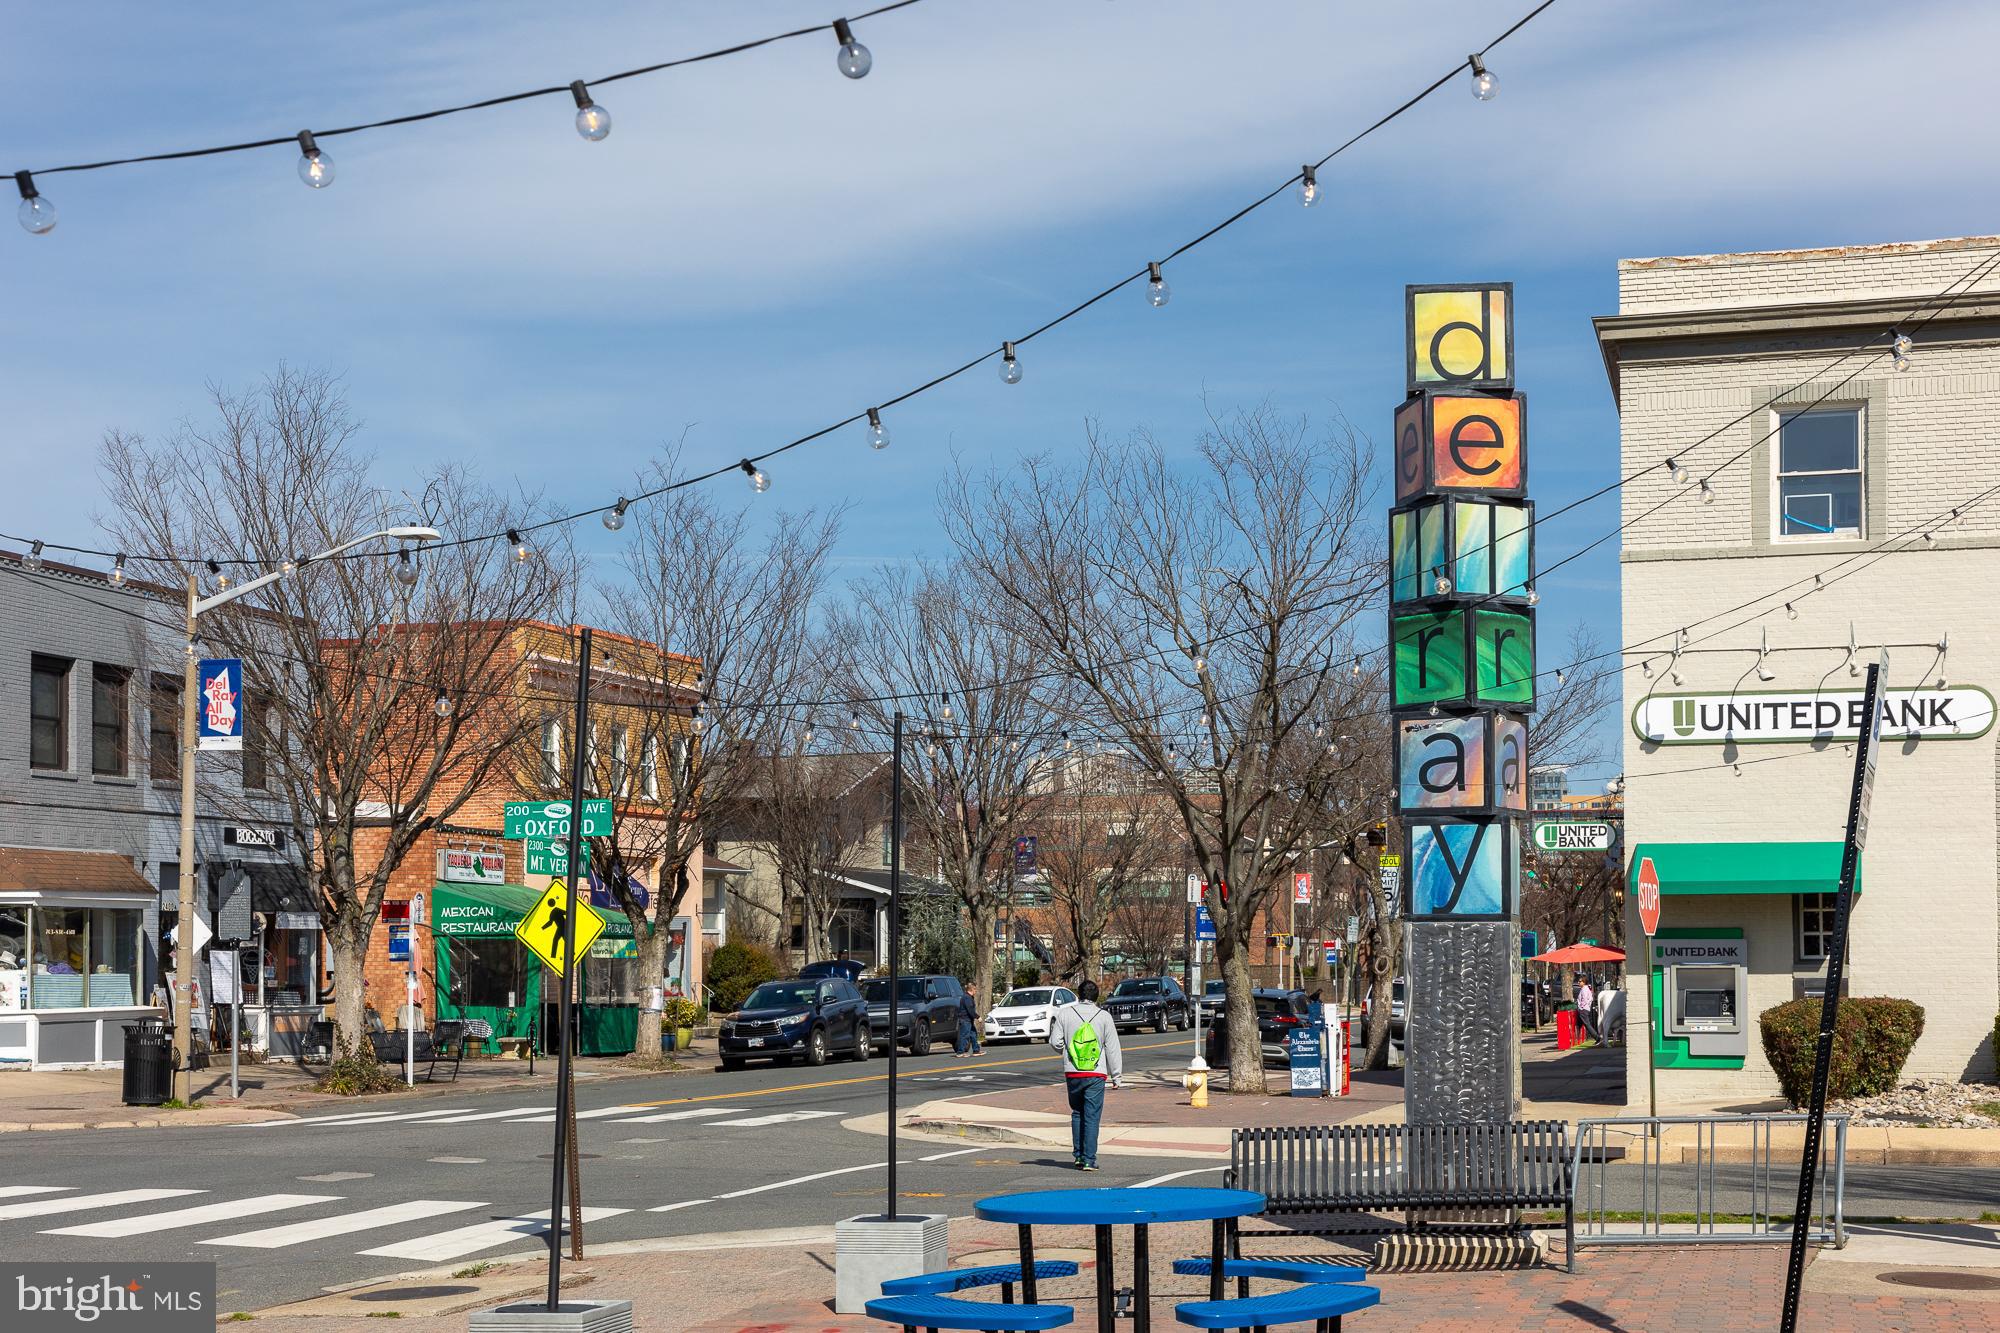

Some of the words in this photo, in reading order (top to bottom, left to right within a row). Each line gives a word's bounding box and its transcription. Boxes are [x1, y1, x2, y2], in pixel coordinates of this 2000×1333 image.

[206, 677, 226, 689] Del
[212, 689, 237, 704] Ray
[205, 702, 222, 716] All
[210, 714, 236, 728] Day
[1700, 702, 1841, 731] UNITED
[506, 806, 529, 816] 200
[585, 803, 606, 813] AVE
[515, 825, 521, 834] E
[525, 819, 595, 836] OXFOD
[1559, 826, 1607, 836] UNITED
[528, 841, 543, 851] 2300
[1559, 837, 1596, 847] BANK
[531, 855, 545, 871] MT.
[550, 858, 586, 874] VERN
[1640, 882, 1657, 911] STOP
[441, 907, 494, 917] MEXICAN
[1665, 947, 1706, 956] UNITED
[1708, 947, 1738, 956] BANK
